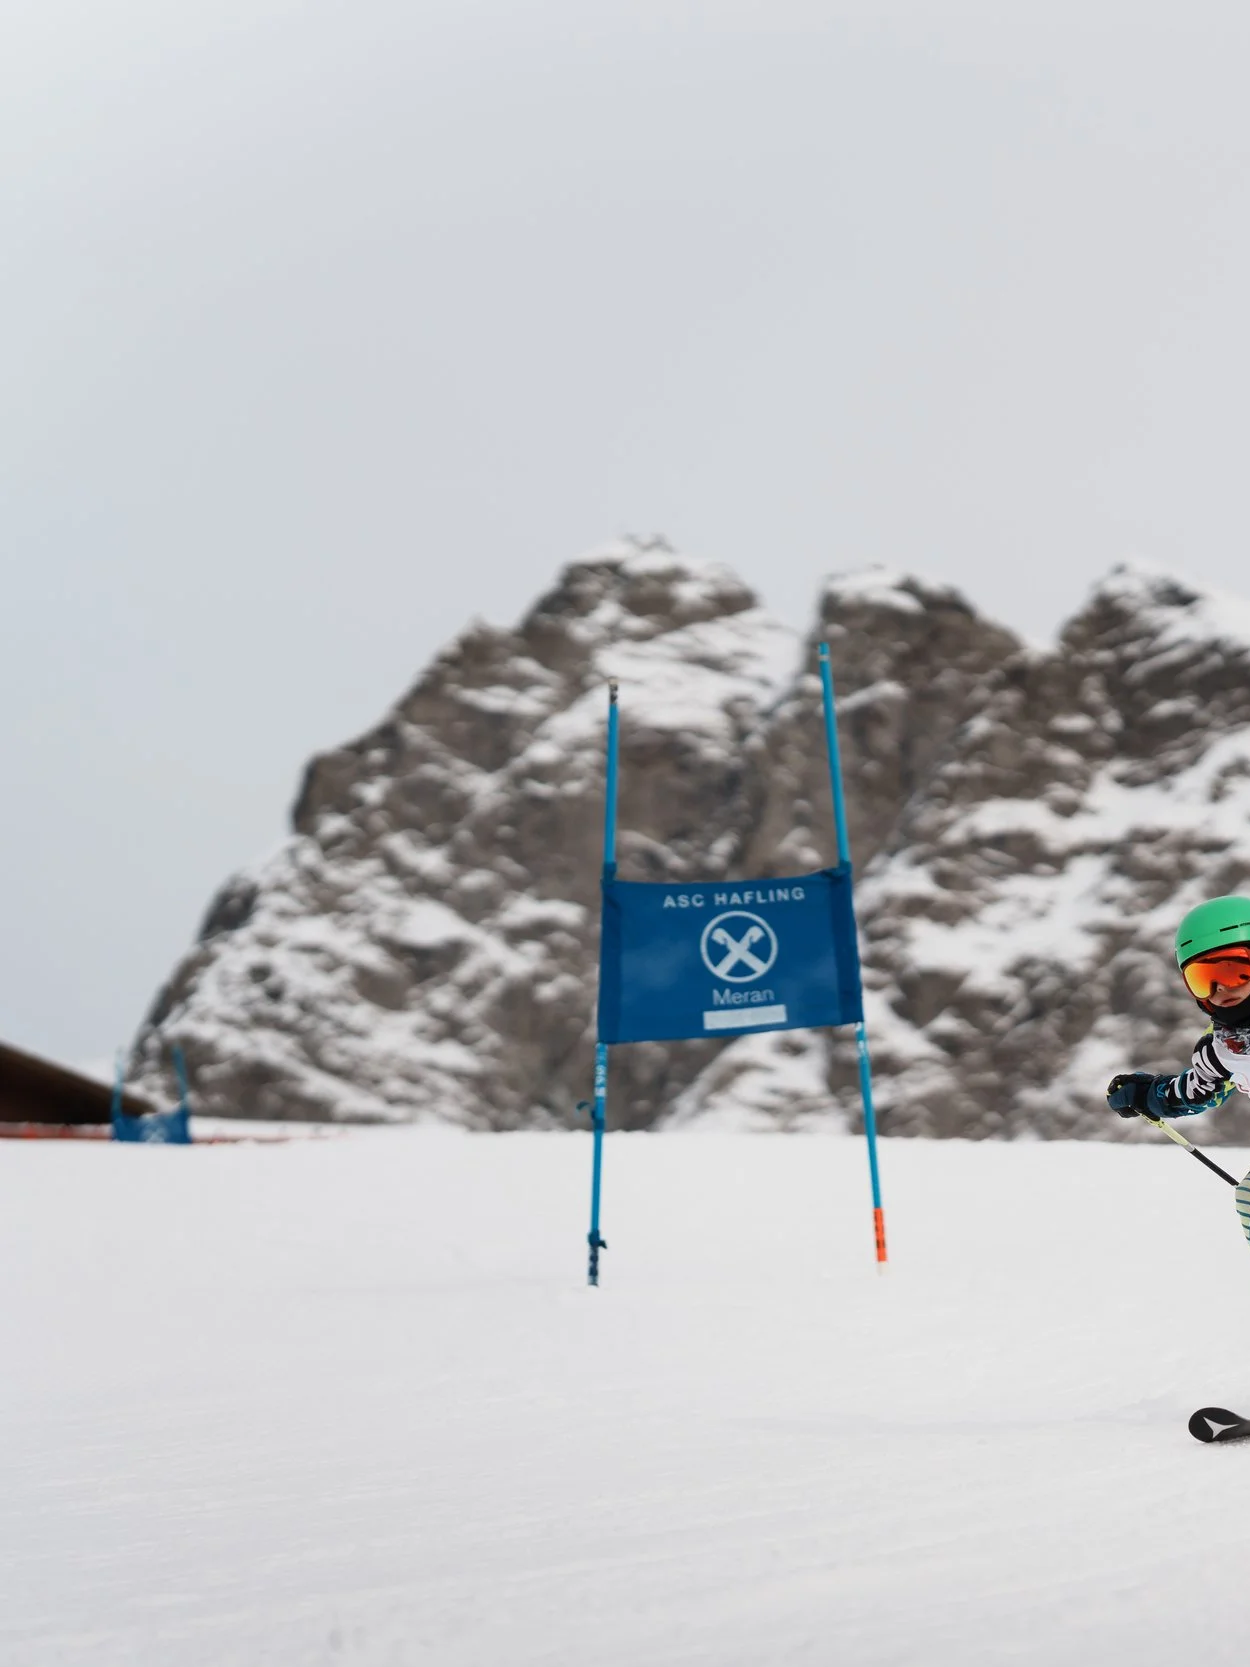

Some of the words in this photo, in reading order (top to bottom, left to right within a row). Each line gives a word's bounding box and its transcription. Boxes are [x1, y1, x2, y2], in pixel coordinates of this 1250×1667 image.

[663, 894, 705, 909] ASC
[714, 887, 806, 906] HAFLING
[712, 988, 775, 1006] Meran
